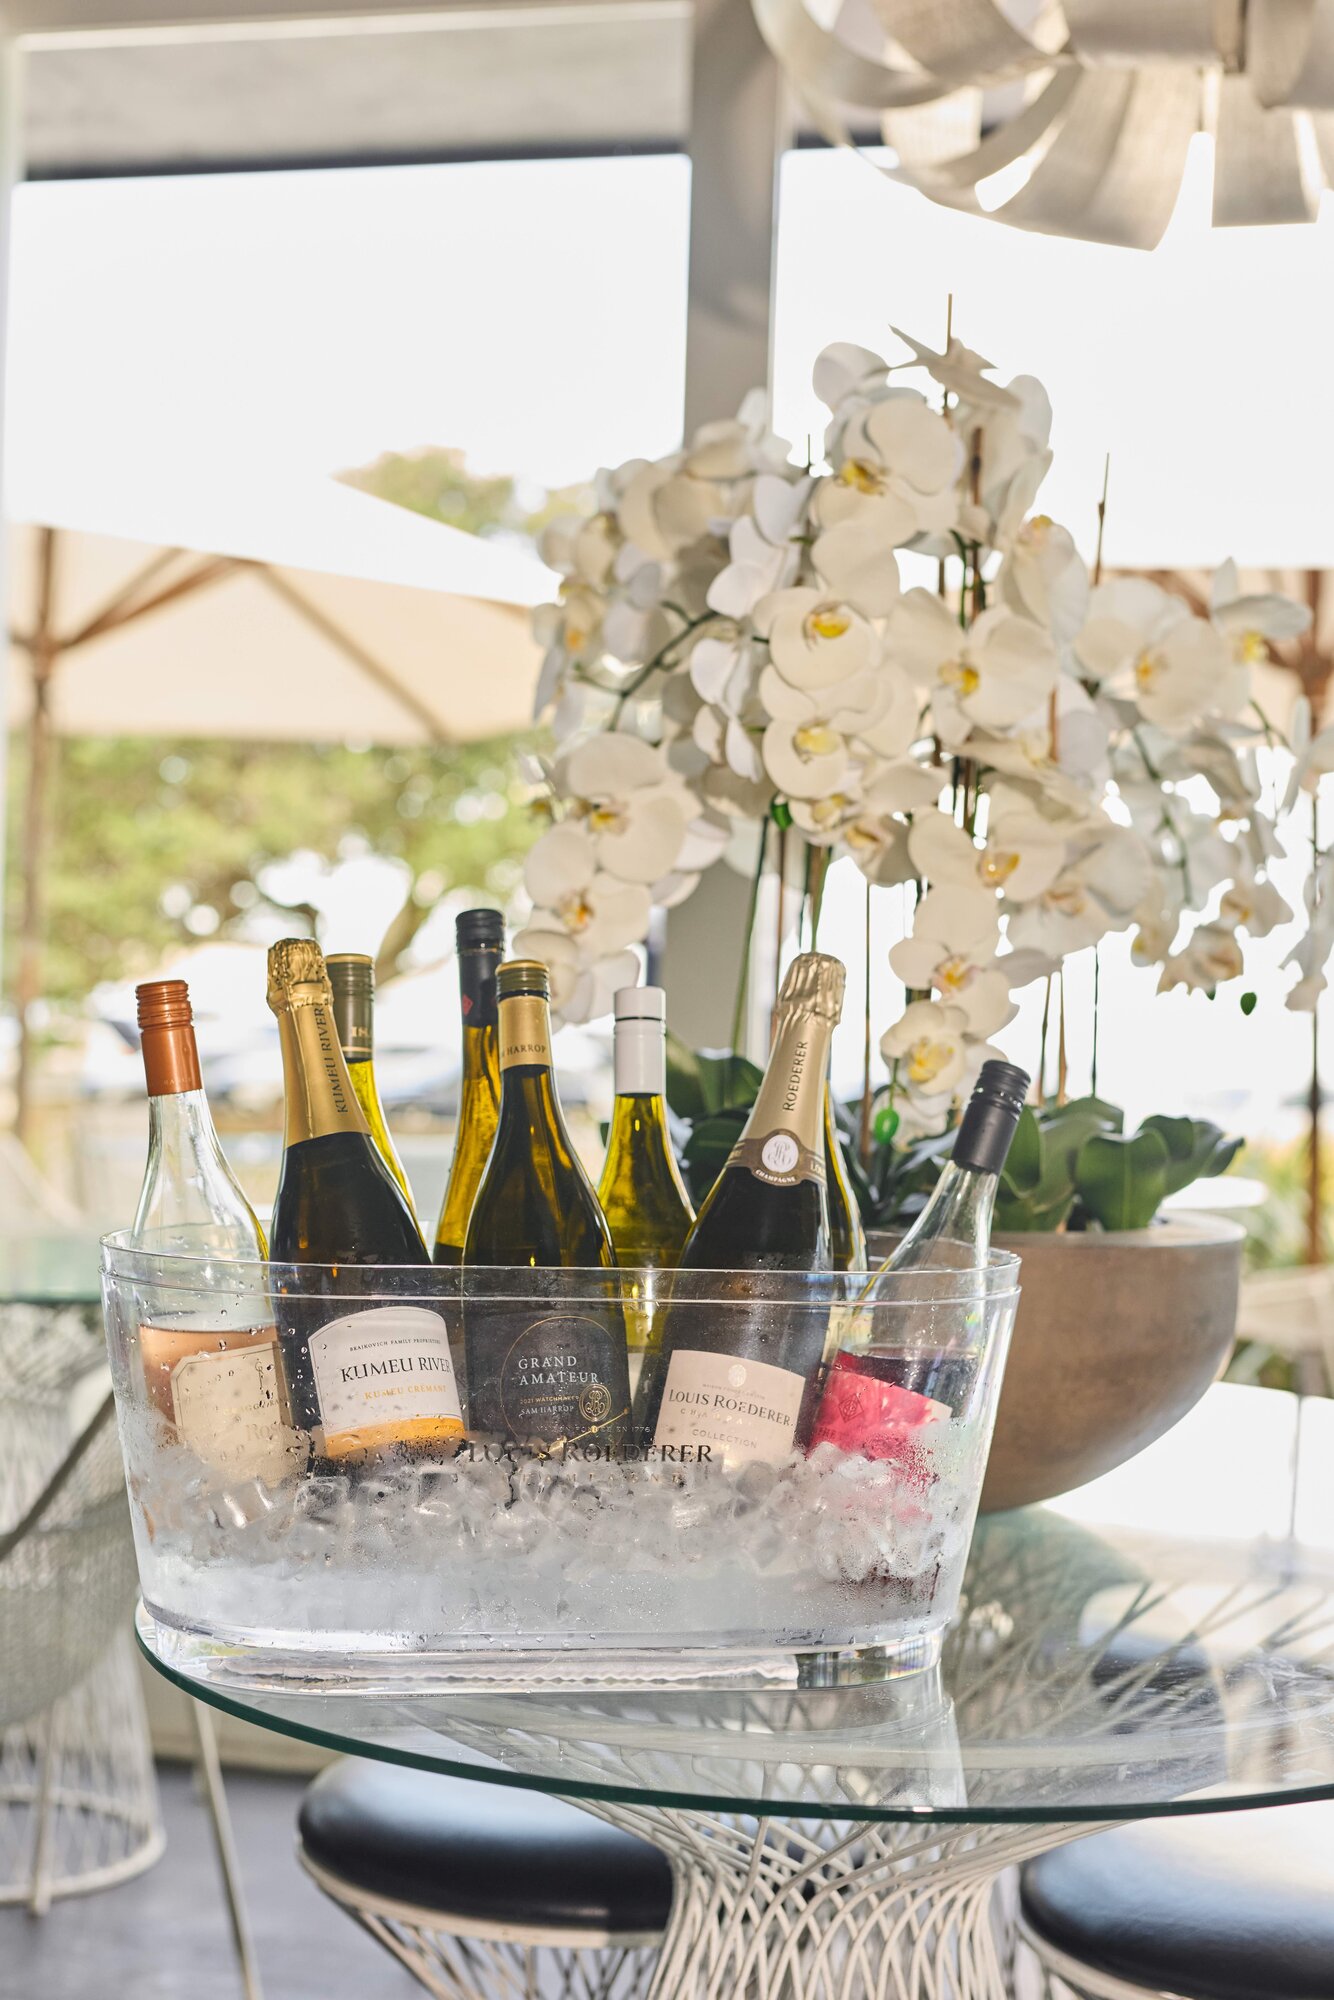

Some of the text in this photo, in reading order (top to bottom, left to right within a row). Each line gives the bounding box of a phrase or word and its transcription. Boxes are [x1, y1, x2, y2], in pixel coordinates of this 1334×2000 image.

[314, 1006, 348, 1113] KUMEU RIVER
[782, 1041, 809, 1112] ROEDERER
[755, 1169, 796, 1183] CHAMPAGNE
[340, 1356, 452, 1383] KUMEU RIVER
[518, 1355, 577, 1370] GRAND
[519, 1371, 599, 1387] AMATEUR
[364, 1386, 404, 1400] KUMEU
[668, 1389, 710, 1406] LOUIS
[520, 1404, 574, 1416] SAM HARROP
[692, 1428, 758, 1449] COLLECTION
